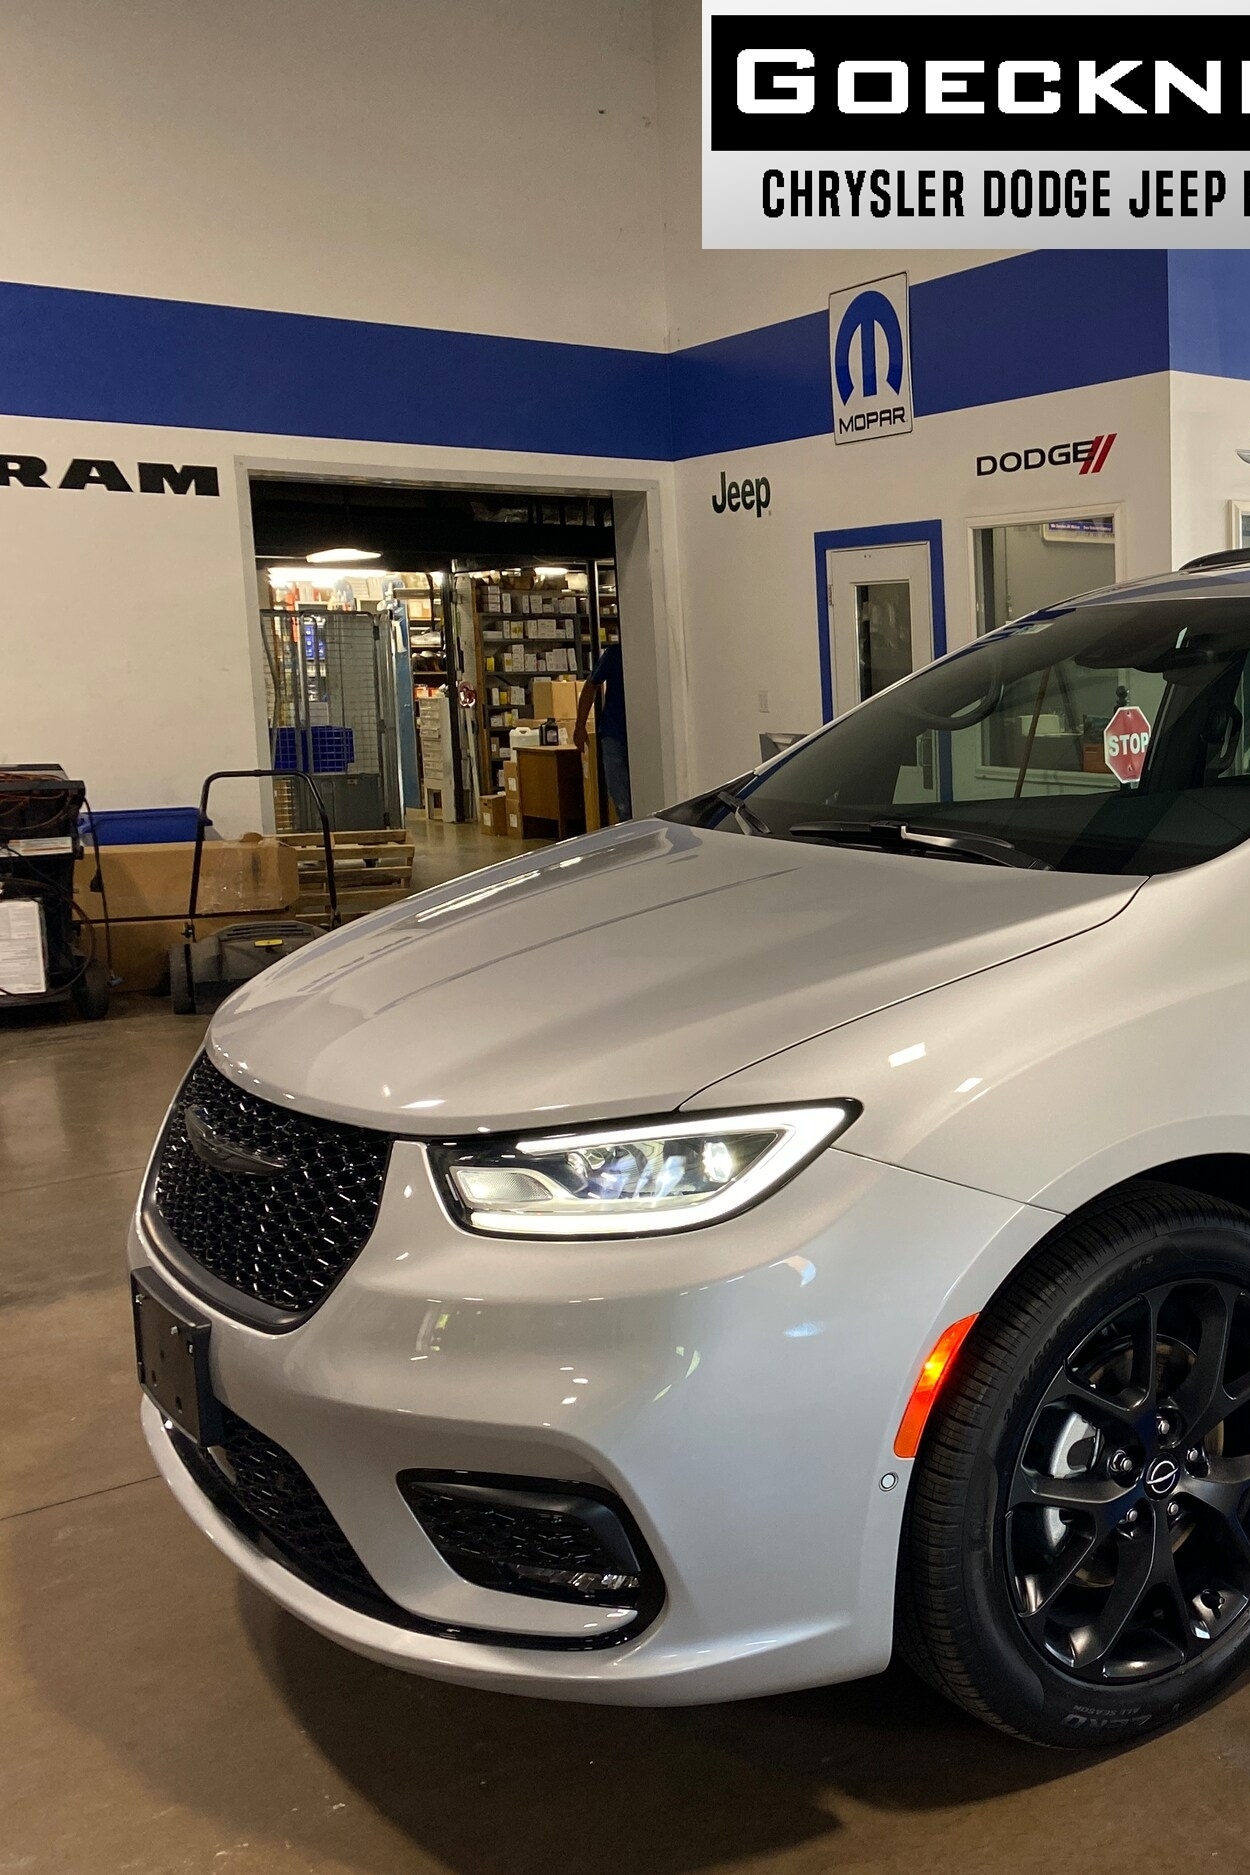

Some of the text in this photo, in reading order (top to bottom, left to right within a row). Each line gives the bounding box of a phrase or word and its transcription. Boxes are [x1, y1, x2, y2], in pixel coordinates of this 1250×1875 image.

[838, 406, 906, 434] MOPAR
[0, 454, 220, 497] RAM
[976, 440, 1095, 477] DODGE
[711, 471, 771, 518] Jeep
[1108, 732, 1149, 757] STOP
